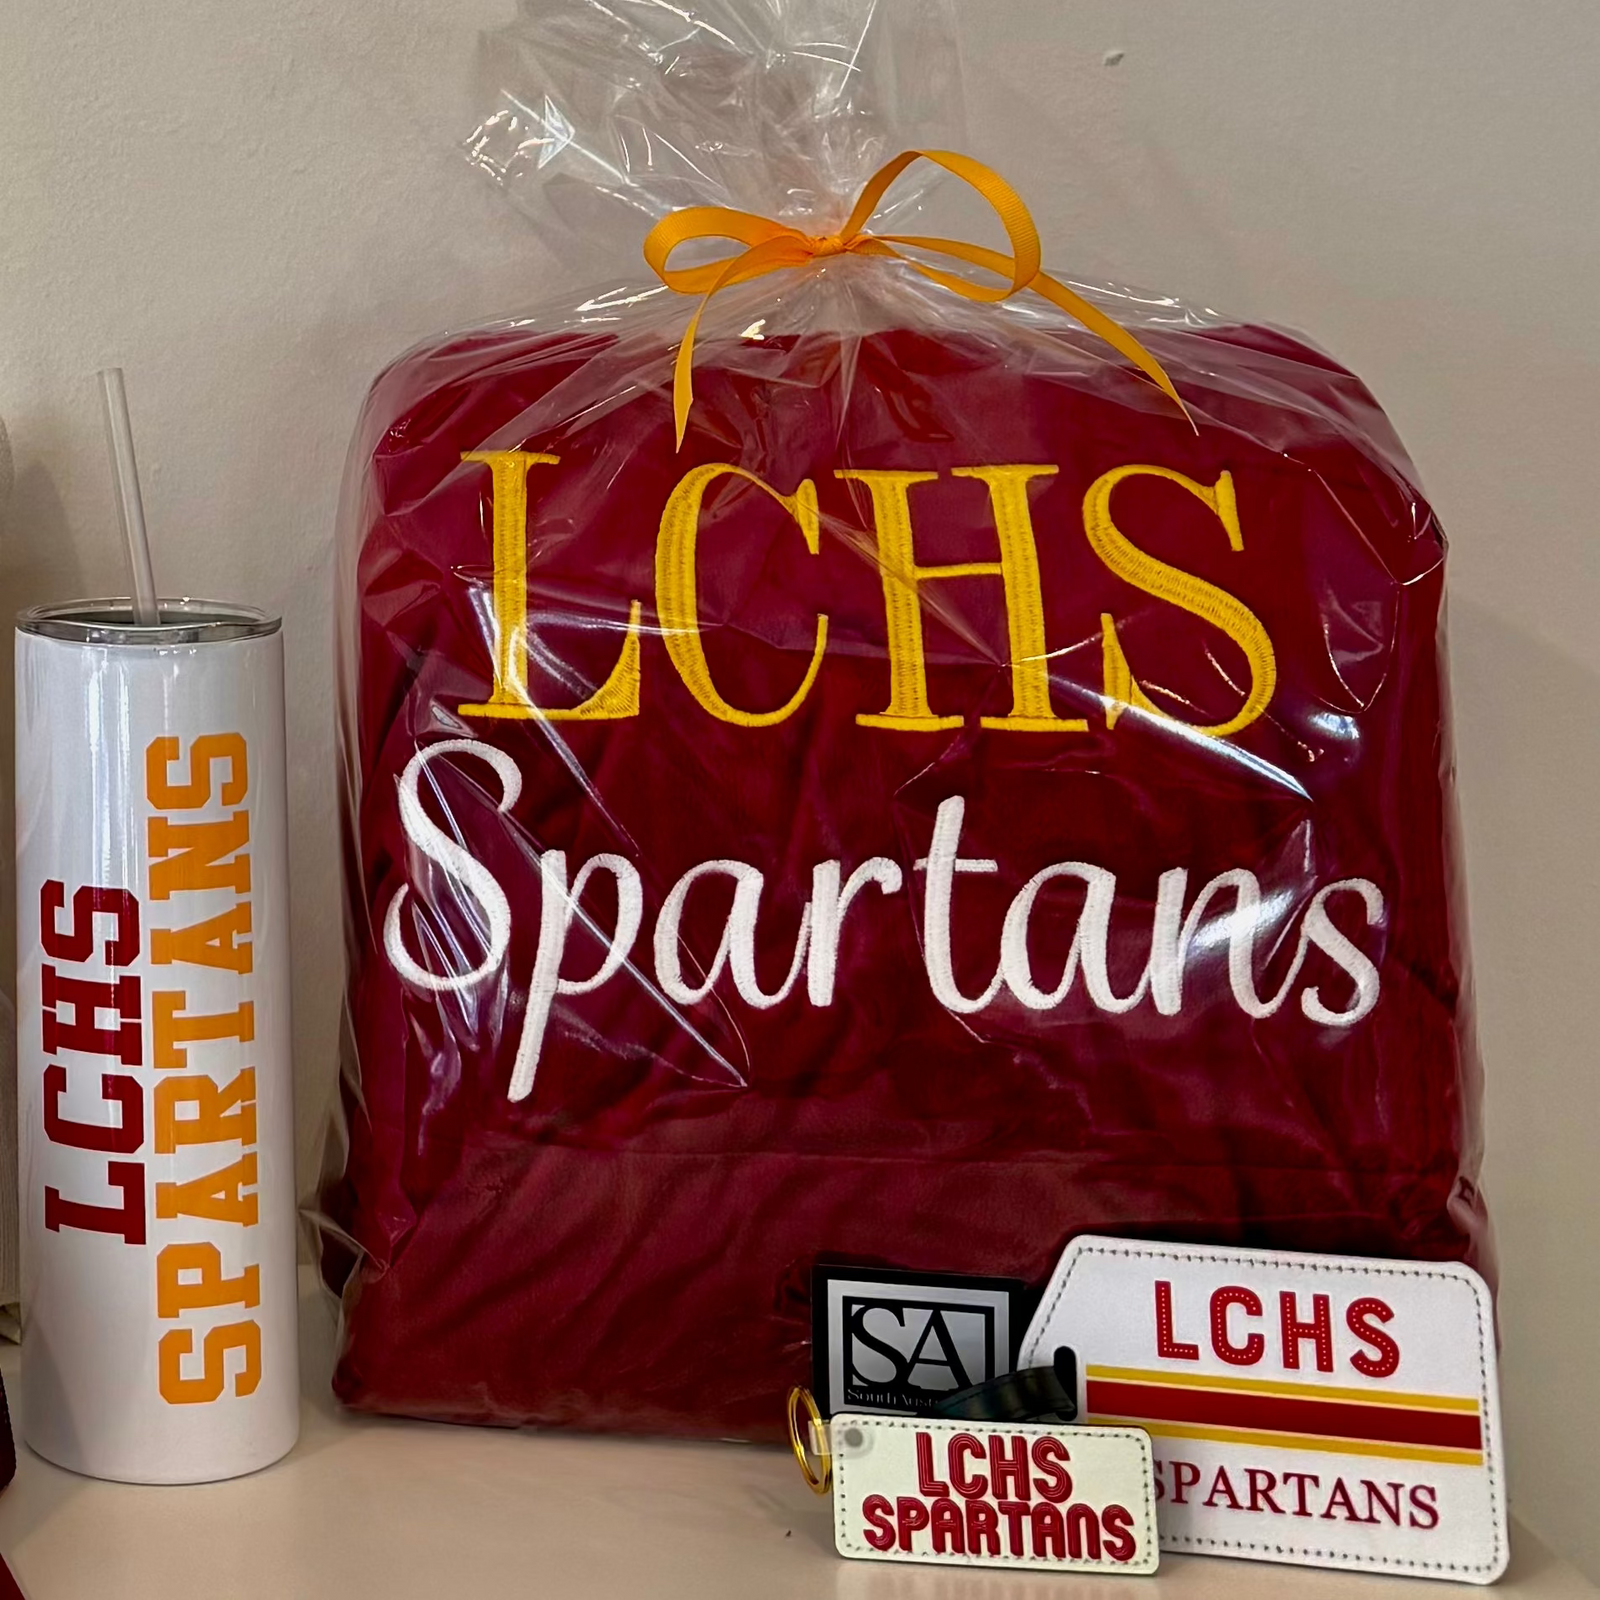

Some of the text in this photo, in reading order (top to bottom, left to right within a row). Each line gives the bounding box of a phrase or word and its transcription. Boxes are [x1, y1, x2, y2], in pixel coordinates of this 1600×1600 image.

[459, 450, 1279, 738] LCHS
[383, 739, 1384, 1102] Spartans
[40, 879, 147, 1245] LCHS
[146, 731, 261, 1405] SPARTANS
[849, 1304, 974, 1391] SA
[1155, 1280, 1400, 1378] LCHS
[863, 1494, 1136, 1561] SPARTANS
[917, 1431, 1073, 1502] LCHS
